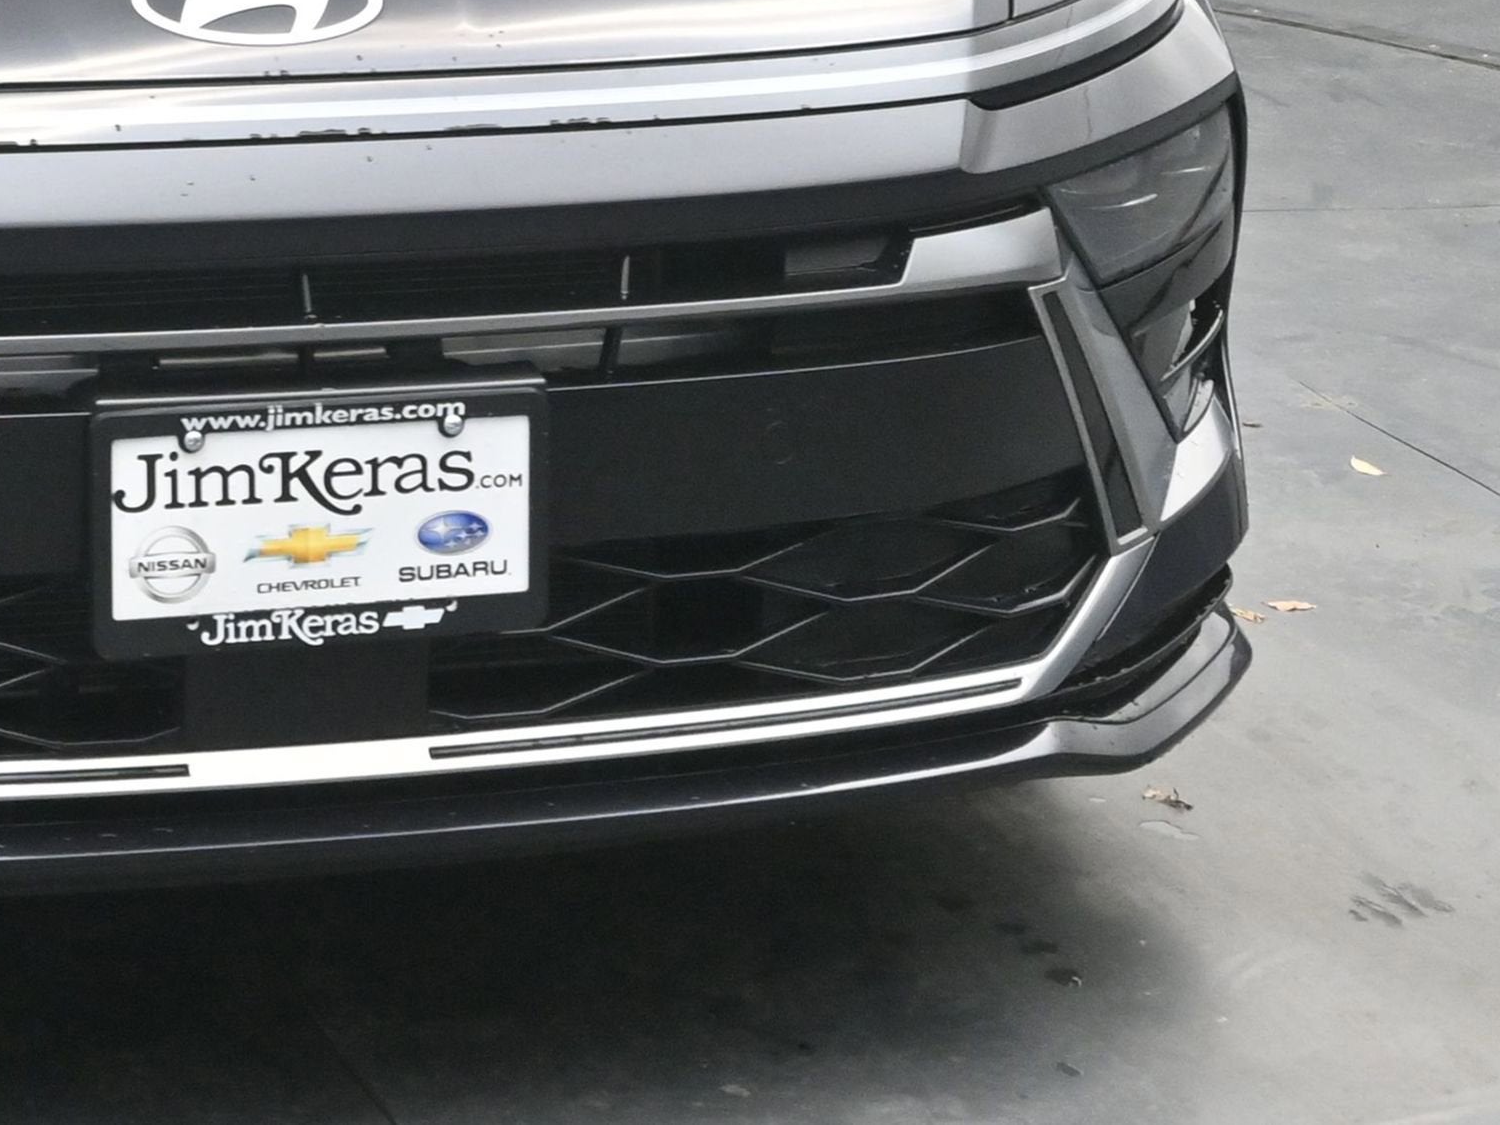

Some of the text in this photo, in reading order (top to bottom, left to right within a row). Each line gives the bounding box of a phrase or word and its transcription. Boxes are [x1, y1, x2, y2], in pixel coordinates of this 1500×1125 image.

[180, 401, 466, 431] www.jimkeras.com
[137, 558, 208, 573] NISSAN
[399, 560, 508, 582] SUBARU
[257, 576, 361, 594] CHEVROLET
[201, 608, 380, 646] JimKeras
